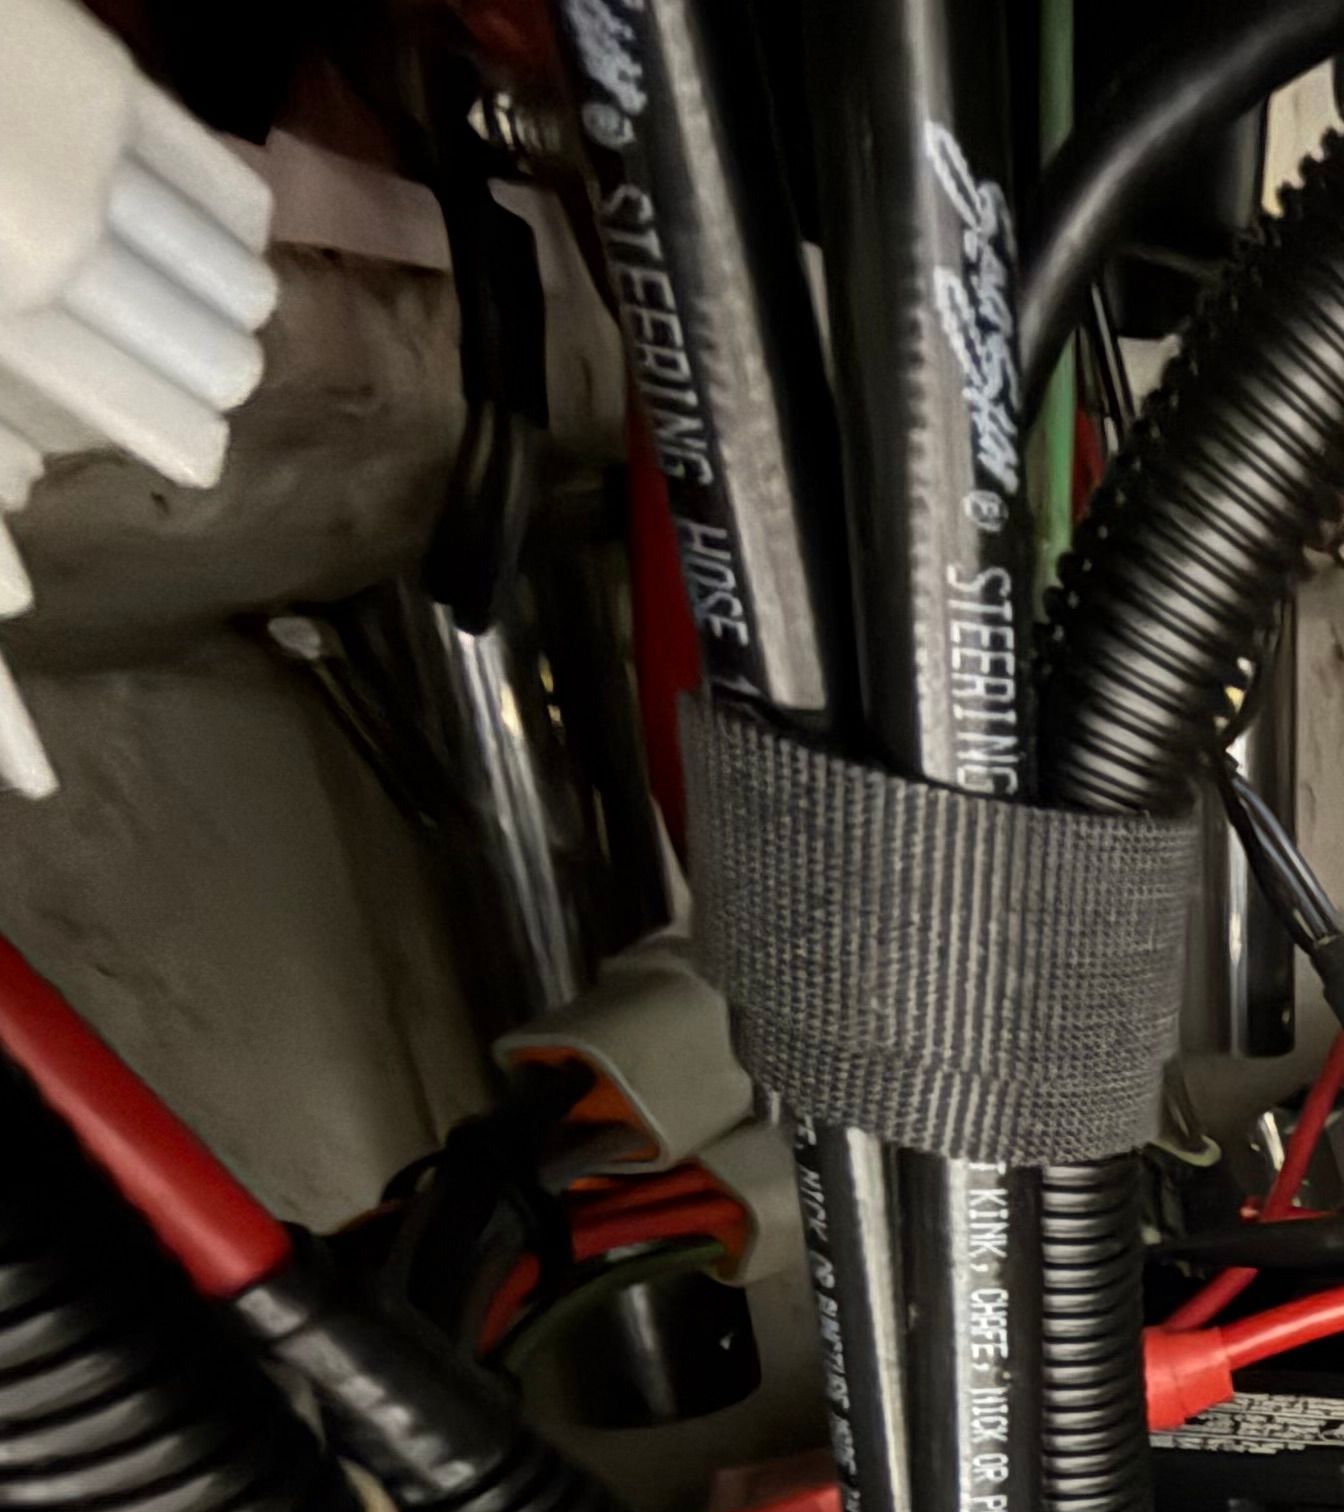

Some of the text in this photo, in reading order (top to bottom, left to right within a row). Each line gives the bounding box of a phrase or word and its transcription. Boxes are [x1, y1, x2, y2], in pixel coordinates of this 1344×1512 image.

[600, 184, 715, 488] STEERING
[678, 524, 752, 650] HOSE
[946, 564, 1018, 794] STEERING
[967, 1187, 1009, 1272] KINK,
[969, 1387, 1009, 1443] NICK
[971, 1452, 1009, 1484] OR
